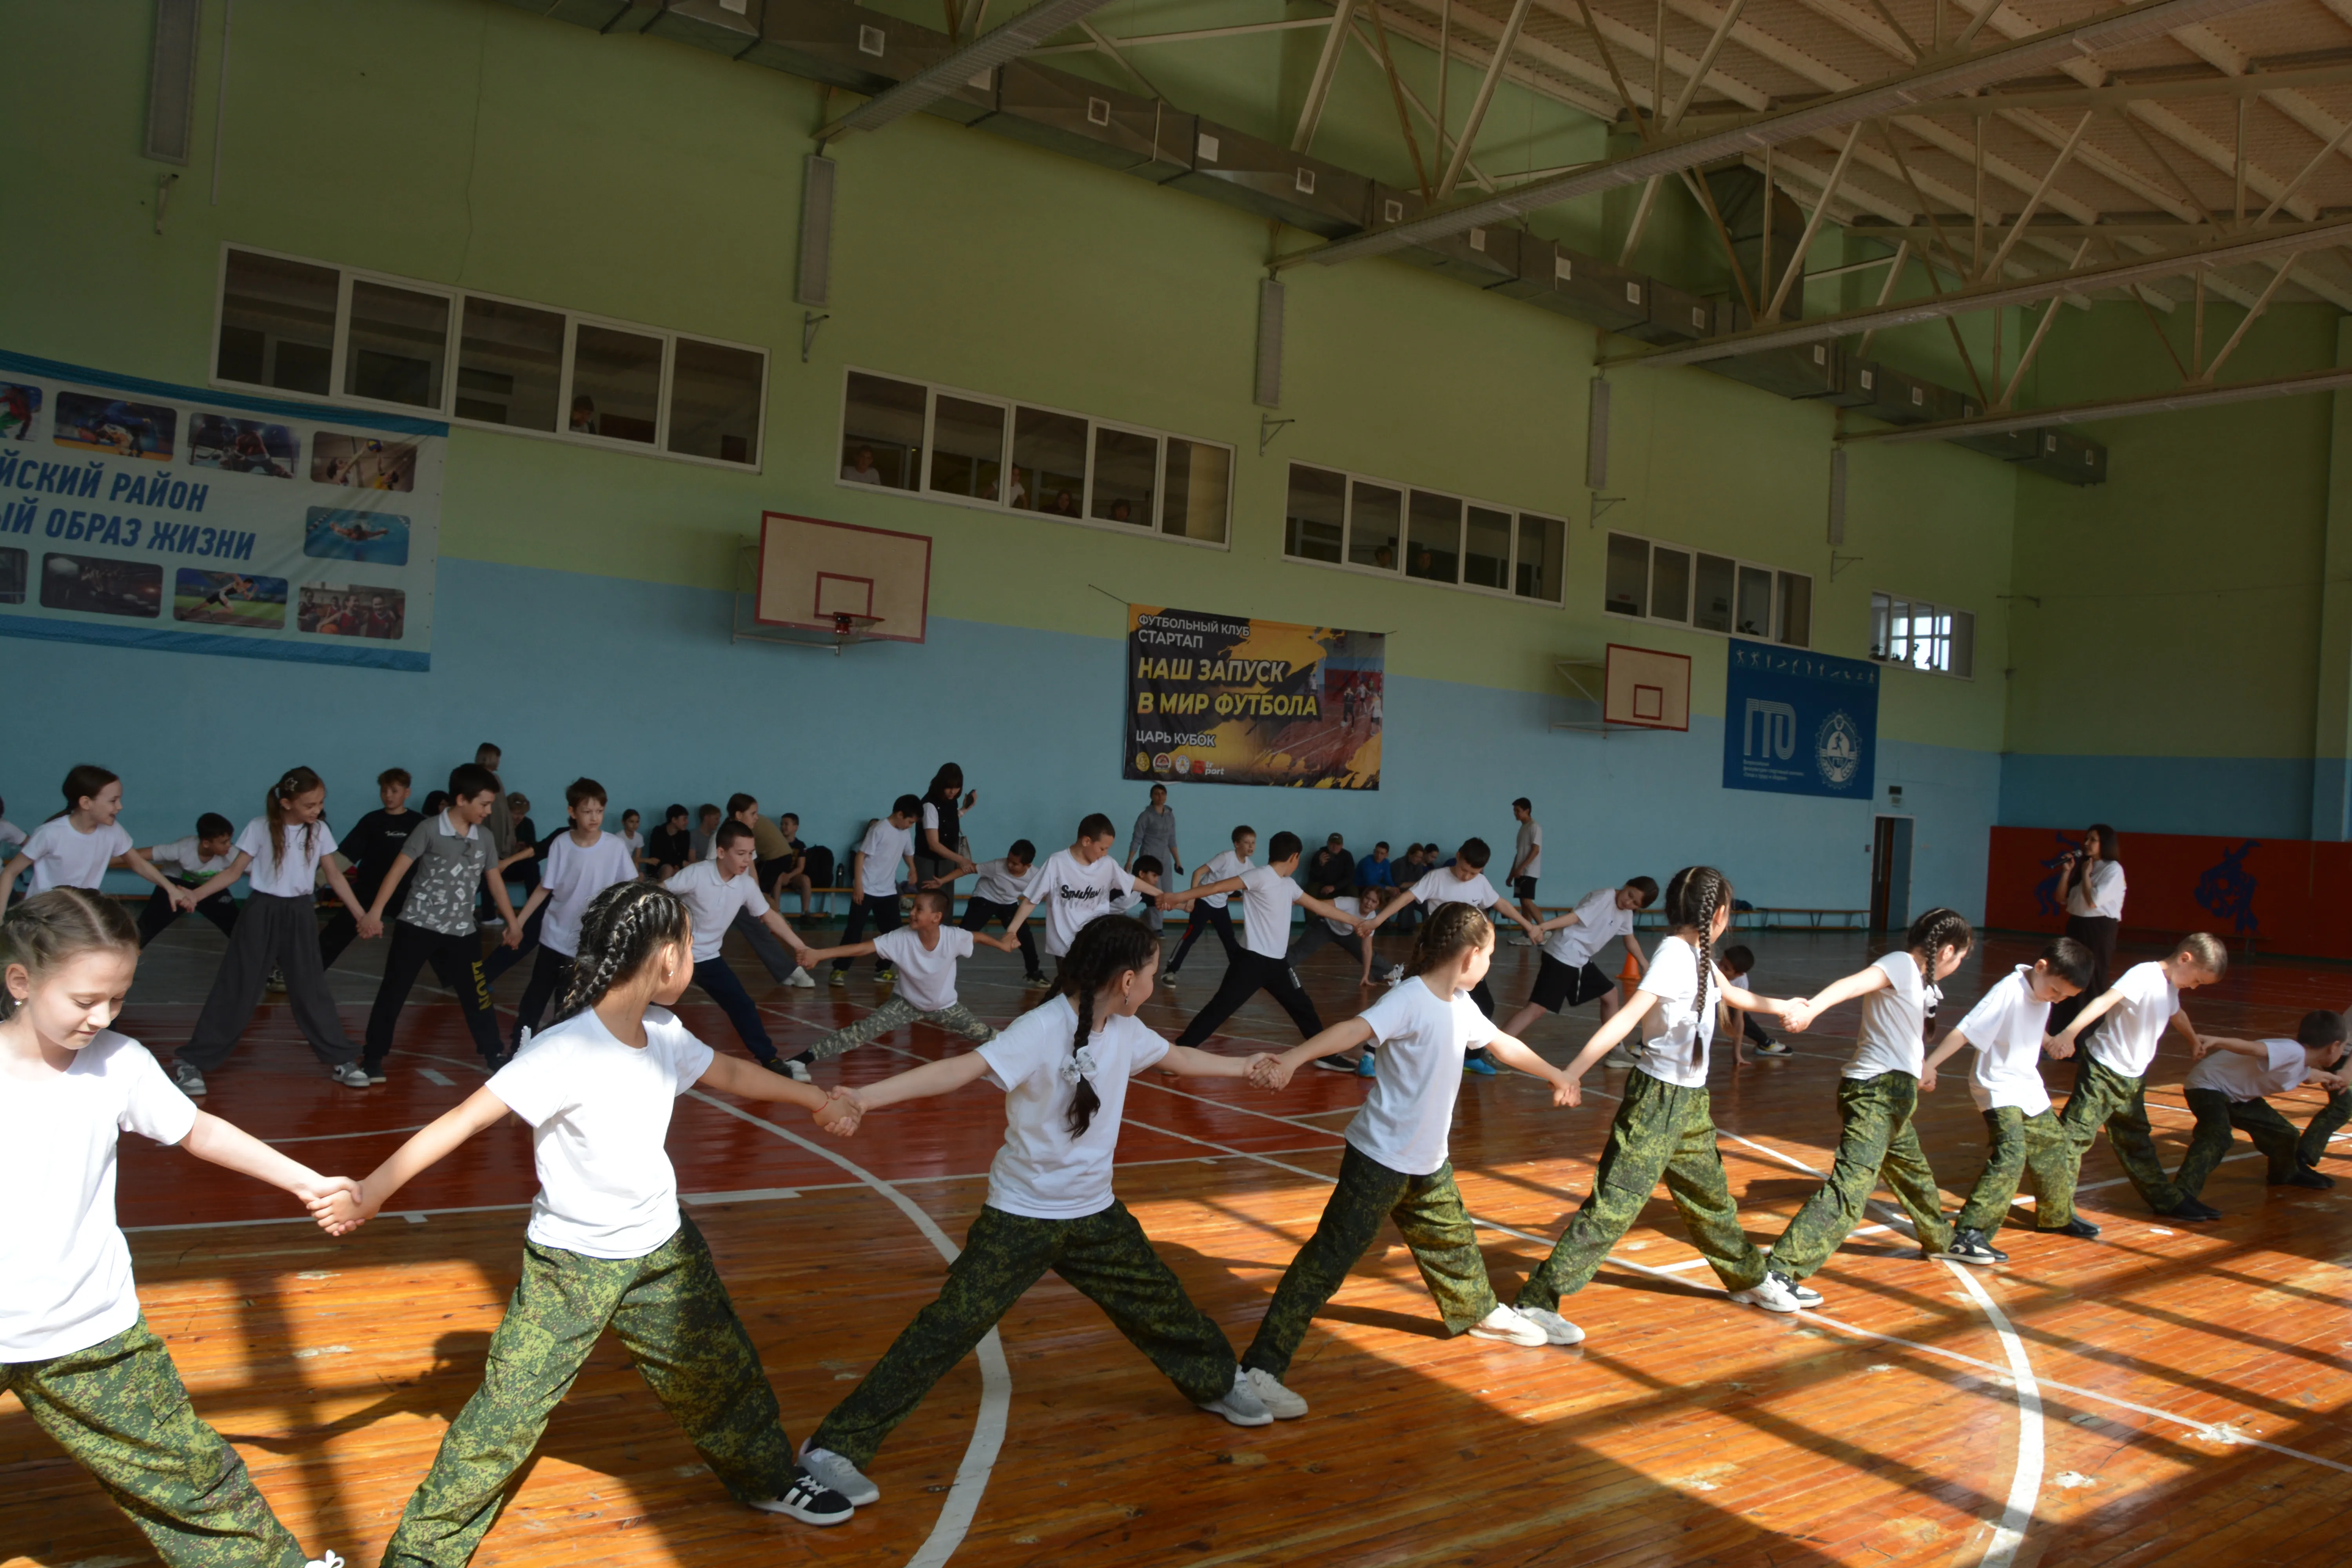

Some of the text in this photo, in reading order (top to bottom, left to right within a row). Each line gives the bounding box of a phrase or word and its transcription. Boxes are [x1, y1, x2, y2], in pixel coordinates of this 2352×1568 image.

[0, 448, 209, 512] ЙСКИЙ РАЙОН
[45, 508, 142, 547] ОБРАЗ
[147, 521, 256, 561] ЖИЗНИ
[1138, 614, 1250, 636] ФУТБОЛЬНЫЙ КЛУБ
[1138, 630, 1203, 648] СТАРТАП
[1137, 657, 1286, 682] НАШ ЗАПУСК
[1137, 692, 1318, 716] В МИР ФУТБОЛА
[1136, 730, 1216, 747] ЦАРЬ КУБОК
[1743, 698, 1797, 760] ГТО
